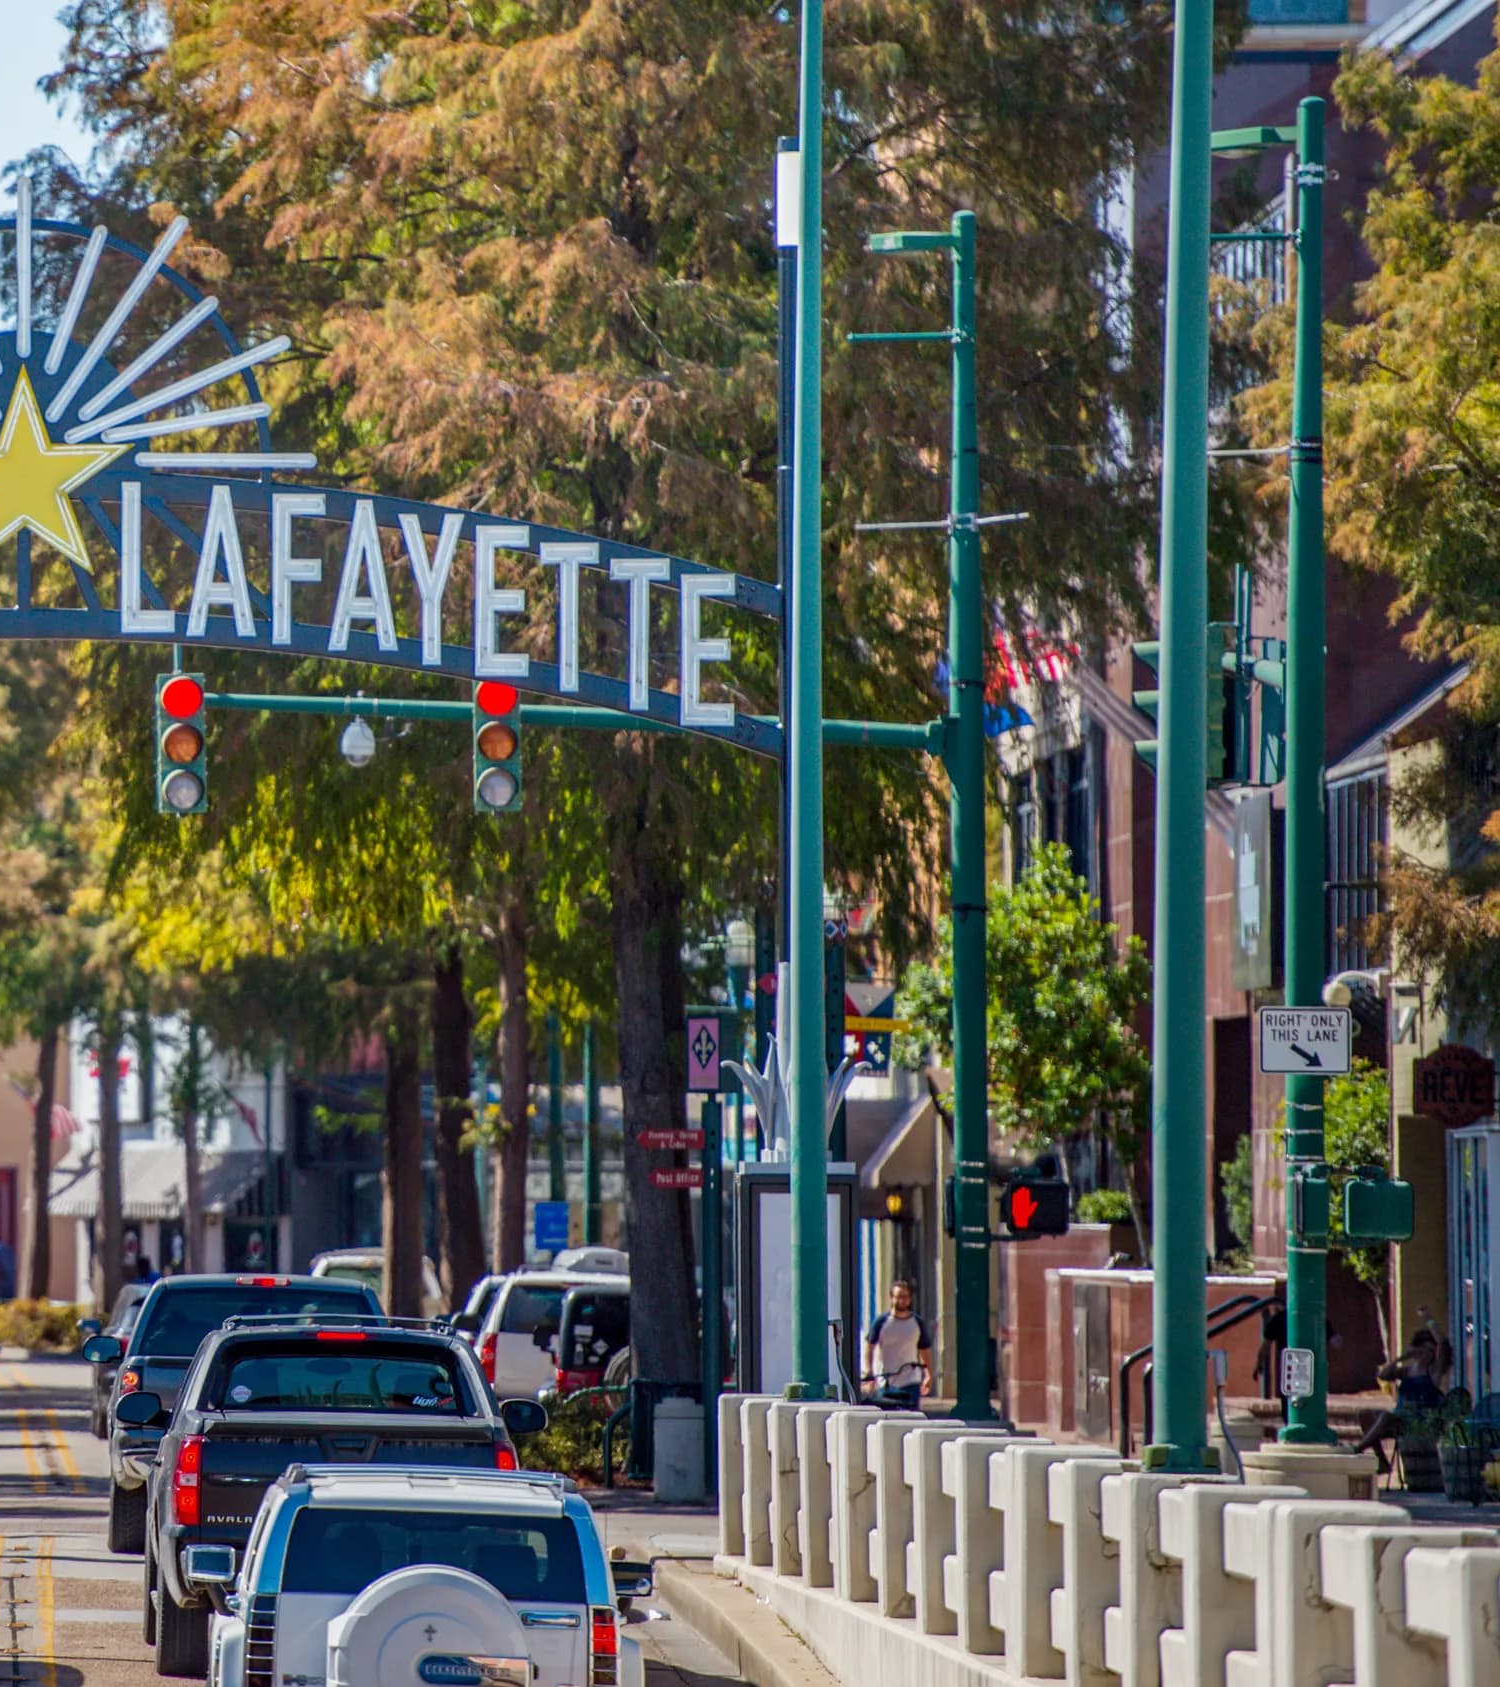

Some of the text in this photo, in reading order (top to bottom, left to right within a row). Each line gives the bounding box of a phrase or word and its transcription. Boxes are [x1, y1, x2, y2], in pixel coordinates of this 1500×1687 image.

[120, 480, 736, 727] LAFAYETTE
[1265, 1014, 1344, 1027] RIGHT ONLY
[1271, 1029, 1339, 1043] THIS LANE
[656, 1173, 700, 1185] Post Office
[207, 1515, 253, 1524] AVALA
